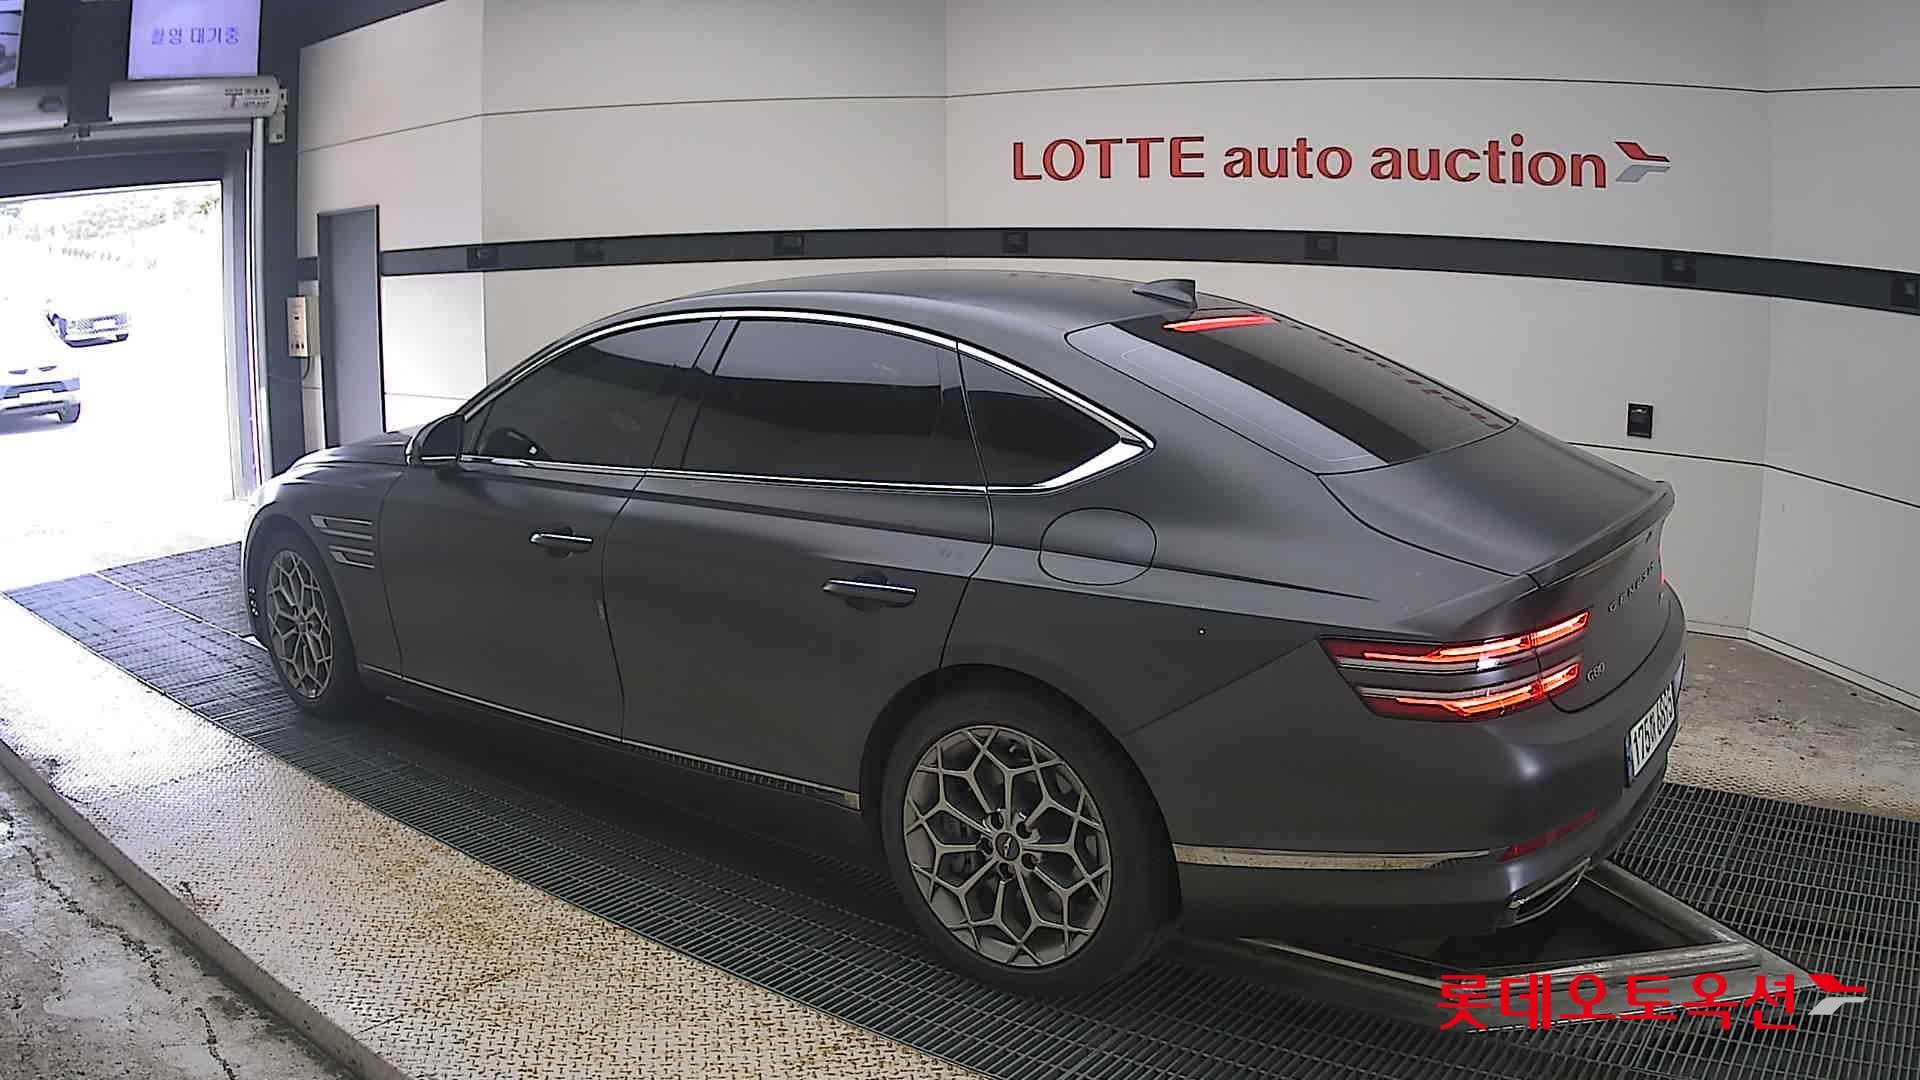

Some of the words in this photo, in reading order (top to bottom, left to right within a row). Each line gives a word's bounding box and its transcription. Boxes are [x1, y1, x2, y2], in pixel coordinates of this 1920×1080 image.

[190, 27, 239, 46] 대기중
[1012, 135, 1206, 182] LOTTE
[1222, 137, 1353, 180] auto
[1370, 132, 1607, 189] auction
